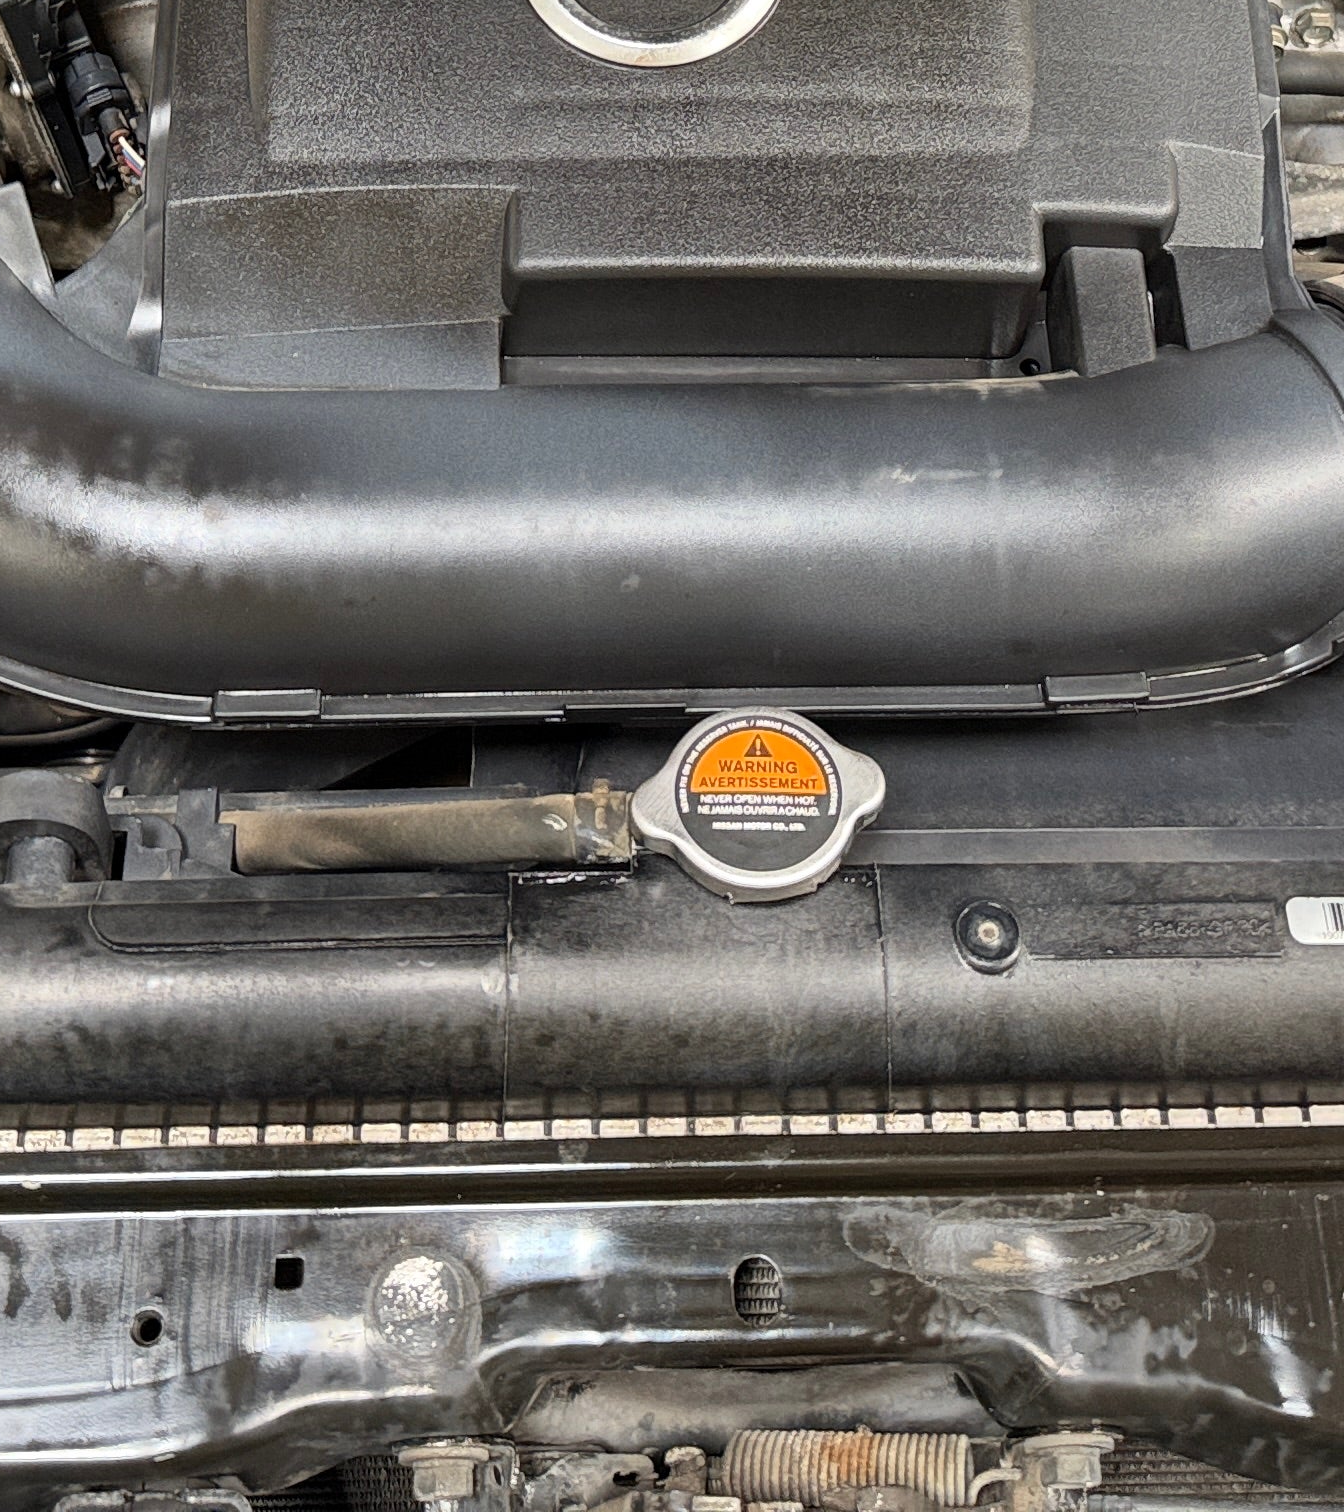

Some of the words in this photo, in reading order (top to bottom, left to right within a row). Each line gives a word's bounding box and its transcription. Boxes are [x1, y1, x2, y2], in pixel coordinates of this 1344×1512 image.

[718, 759, 798, 774] WARNING
[699, 776, 818, 790] AVERTISSEMENT
[699, 794, 733, 805] NEVER
[733, 794, 762, 805] OPEN
[762, 794, 794, 806] WHEN
[794, 795, 818, 806] HOT.
[697, 804, 711, 816] NE
[710, 804, 744, 816] JAMAIS
